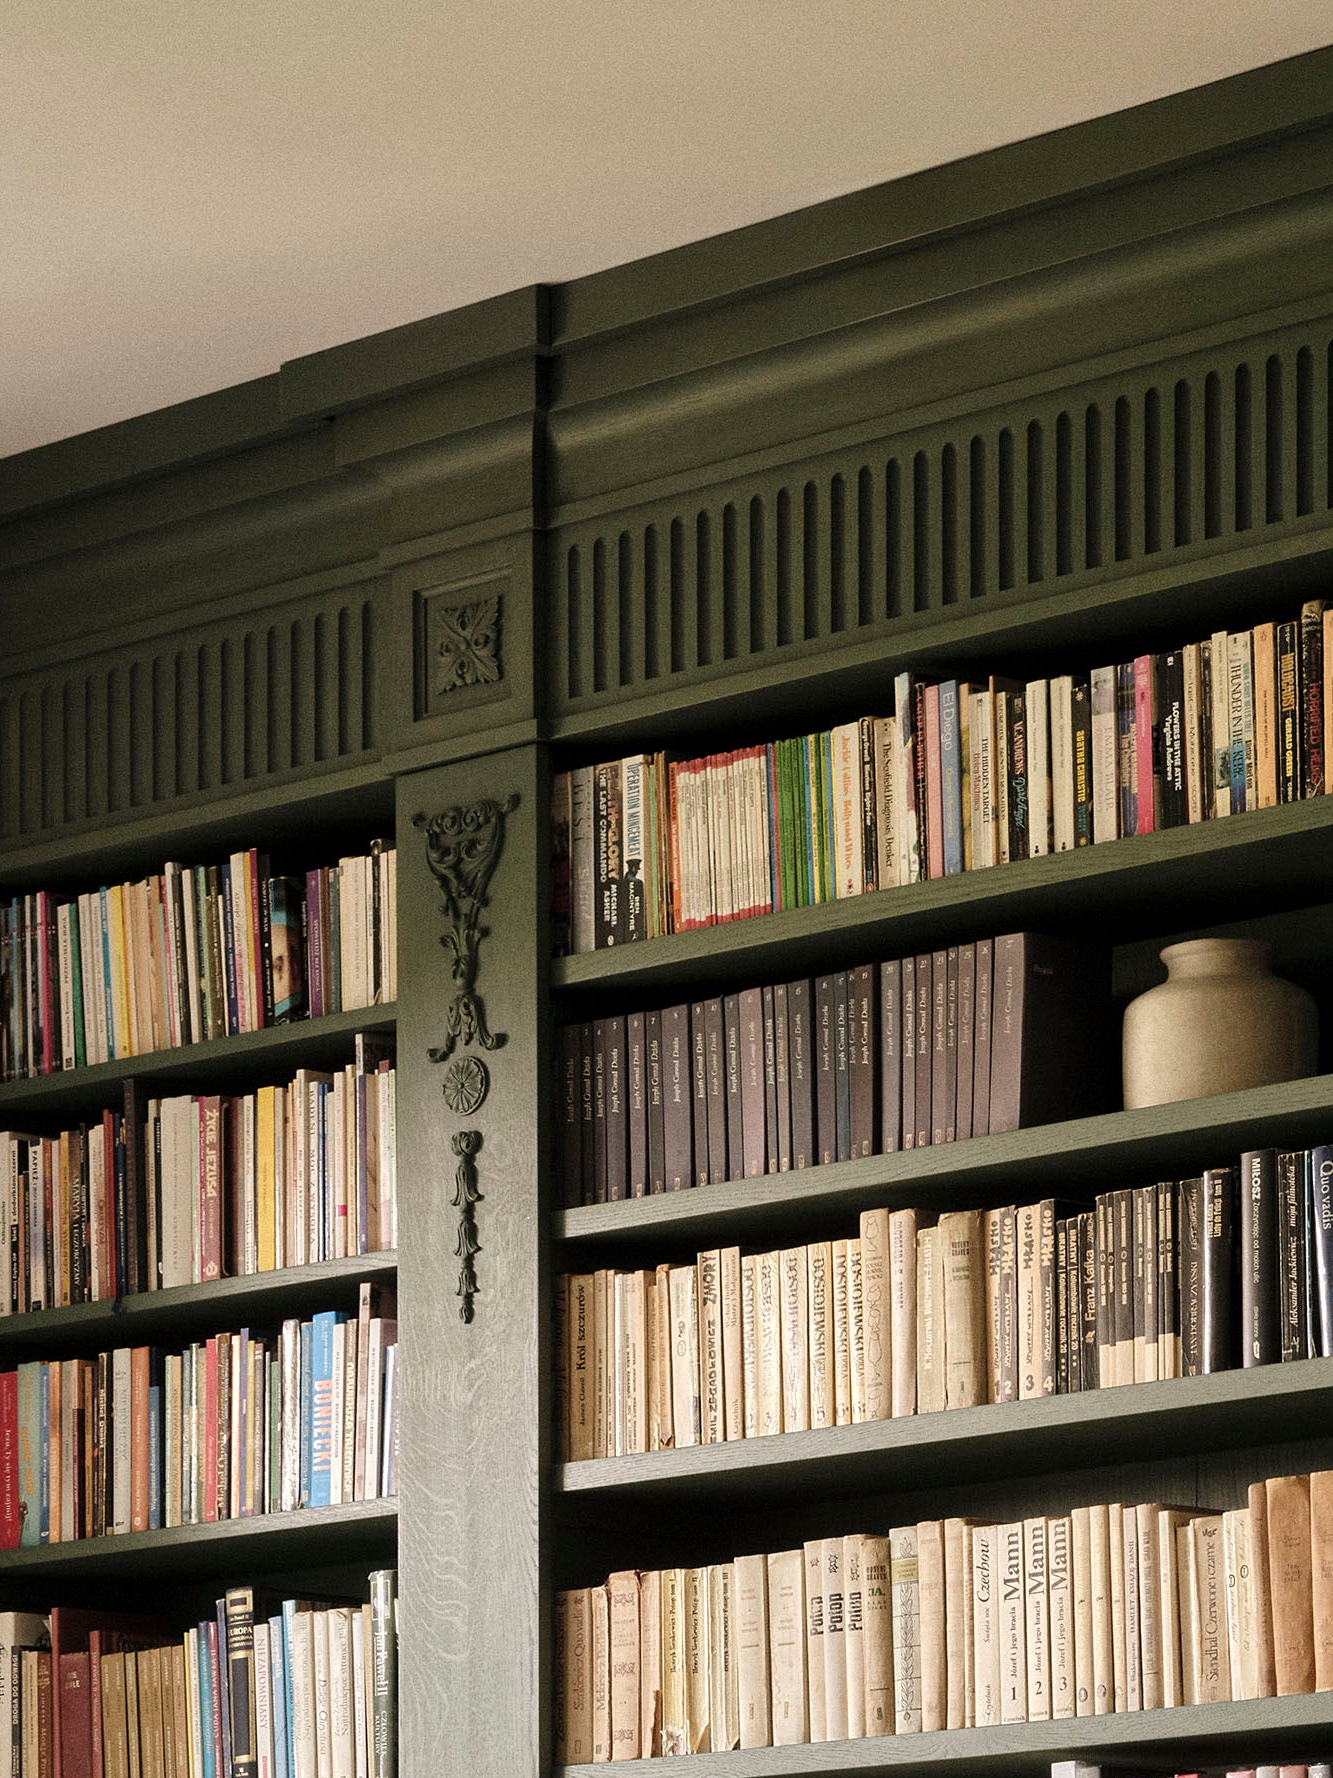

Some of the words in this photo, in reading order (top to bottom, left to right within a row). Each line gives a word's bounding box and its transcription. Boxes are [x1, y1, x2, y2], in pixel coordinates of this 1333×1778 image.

[943, 693, 952, 706] El
[1231, 664, 1242, 713] THUNDER
[1281, 653, 1295, 712] HOLOCAUST
[942, 708, 954, 751] Diego
[1164, 716, 1172, 745] Virginia
[1233, 716, 1242, 727] IN
[1309, 683, 1320, 744] HORRIFIED
[1174, 741, 1180, 750] IN
[1233, 729, 1242, 747] THE
[1285, 718, 1293, 749] GERALD
[1233, 751, 1243, 777] KERK
[1311, 749, 1321, 784] HEIRS
[627, 764, 639, 809] OPERATION
[599, 819, 607, 882] COMMANDO
[628, 812, 640, 857] MINCEMEAT
[206, 1109, 219, 1144] ŻYCIE
[207, 1148, 217, 1197] JEZUSA
[1252, 1158, 1261, 1200] MIŁOSZ
[1287, 1166, 1296, 1203] filmoteka
[1319, 1161, 1333, 1194] Quo
[1252, 1202, 1260, 1238] Zaczynając
[1288, 1205, 1296, 1226] moja
[1321, 1196, 1332, 1229] vadis
[1253, 1240, 1260, 1248] od
[1289, 1237, 1297, 1278] Jackiewicz
[703, 1257, 716, 1305] ZMORY
[1085, 1250, 1094, 1284] Kafka
[837, 1254, 847, 1353] DOSTOJEWSKI
[1070, 1270, 1078, 1313] Kolumbowie
[1085, 1288, 1094, 1320] Franz
[577, 1346, 586, 1370] Król
[1071, 1341, 1078, 1350] 20
[1026, 1375, 1034, 1391] 3
[313, 1380, 332, 1472] BONIECKI
[977, 1539, 991, 1602] Czechow
[1003, 1532, 1020, 1602] Mann
[1028, 1526, 1045, 1595] Mann
[1051, 1522, 1067, 1591] Mann
[1207, 1542, 1216, 1576] czarne
[828, 1594, 843, 1632] Potop
[1206, 1581, 1218, 1634] Czerwone
[1205, 1637, 1217, 1682] Stendhal
[257, 1638, 267, 1729] NIEZAPOMNIANY
[1012, 1687, 1016, 1701] 1
[1035, 1681, 1042, 1695] 2
[1059, 1677, 1067, 1691] 3
